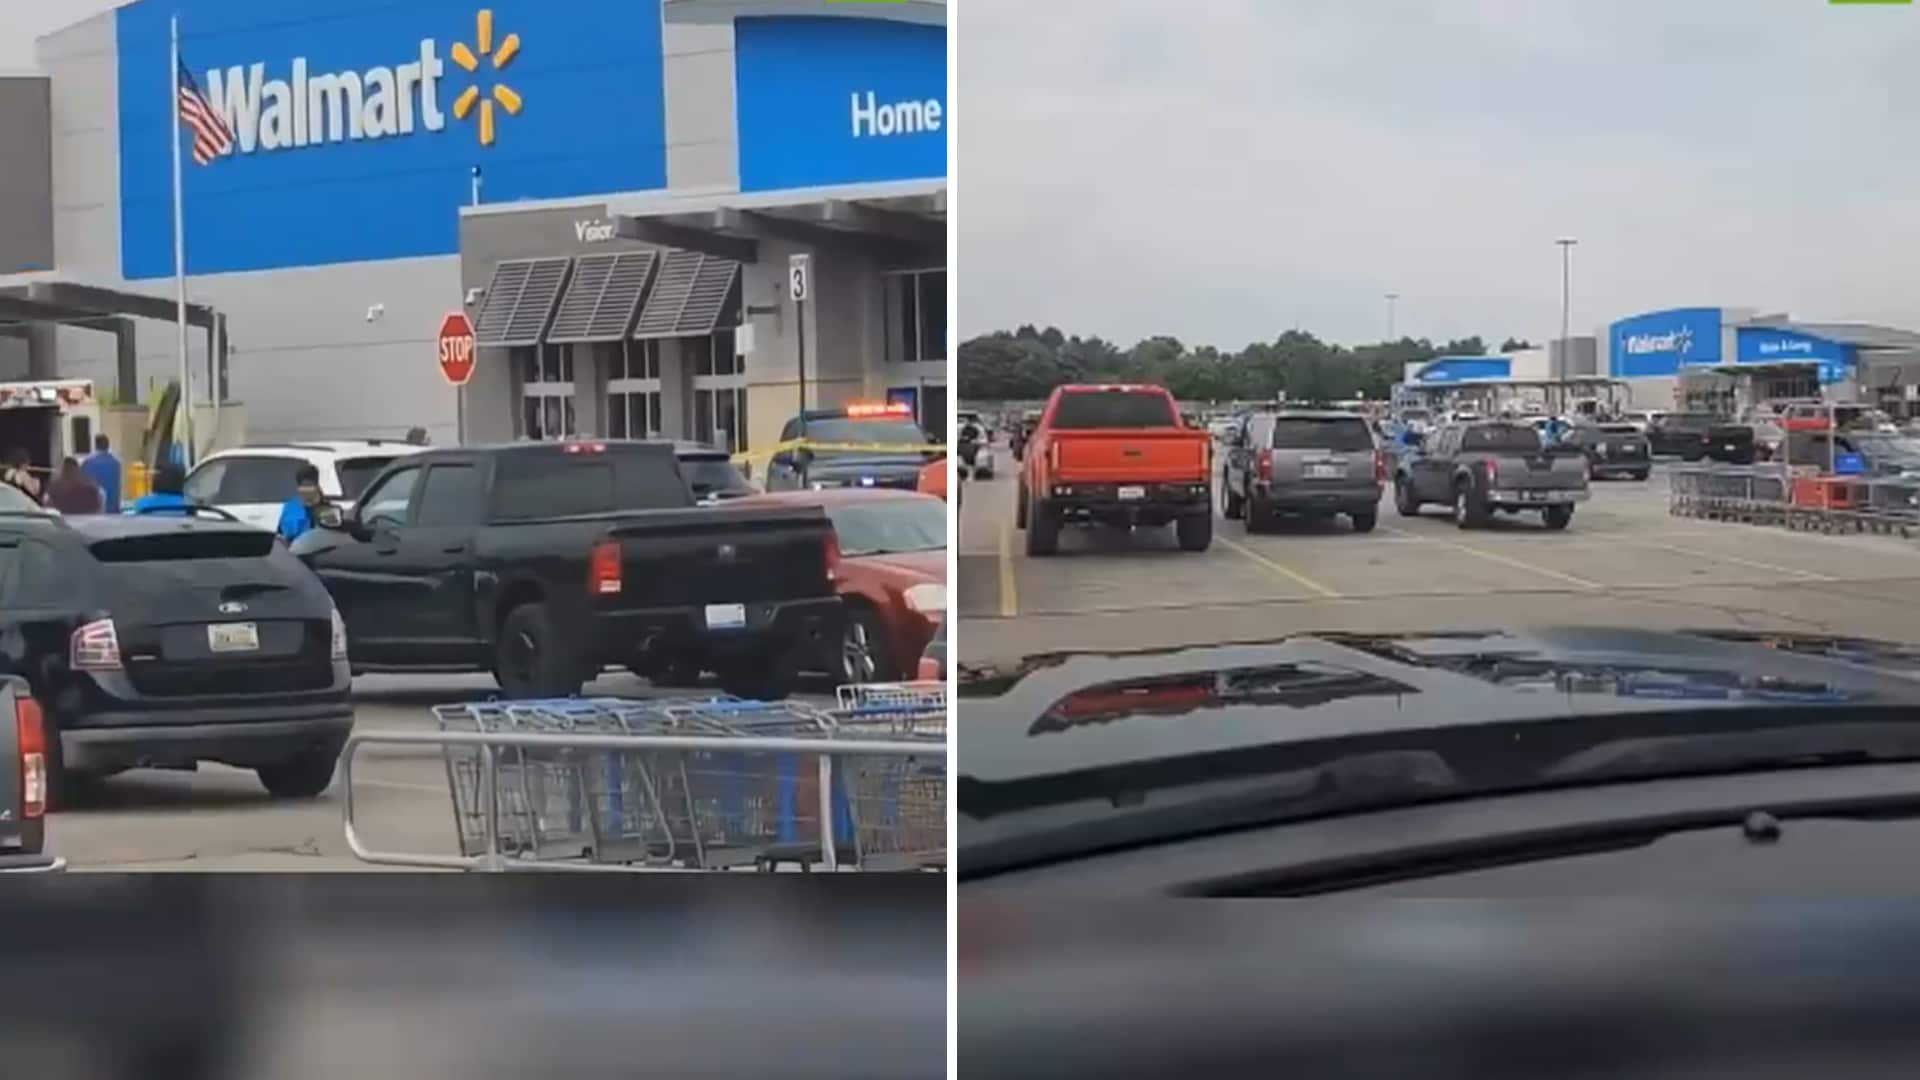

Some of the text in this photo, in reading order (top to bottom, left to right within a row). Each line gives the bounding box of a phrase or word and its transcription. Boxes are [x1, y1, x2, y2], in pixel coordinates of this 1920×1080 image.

[206, 38, 445, 155] Walmart
[851, 90, 941, 137] Home
[794, 269, 804, 298] 3
[441, 335, 473, 363] STOP
